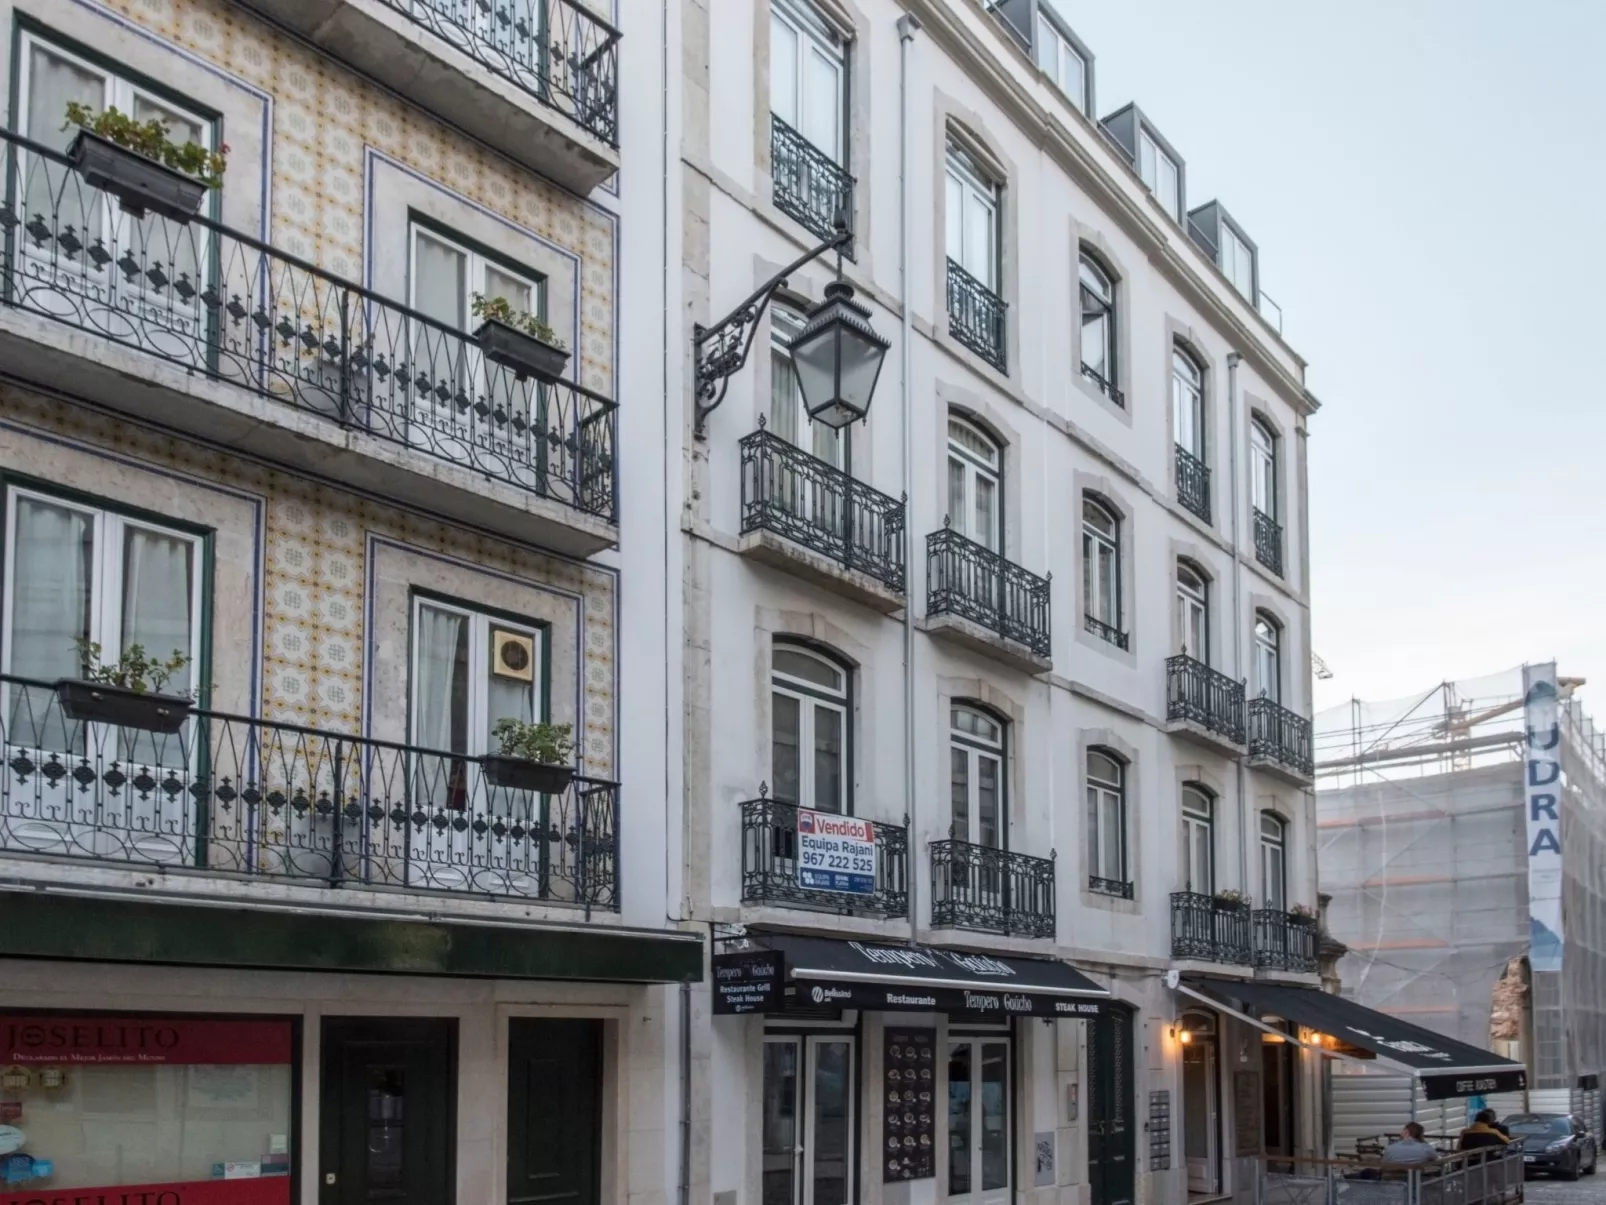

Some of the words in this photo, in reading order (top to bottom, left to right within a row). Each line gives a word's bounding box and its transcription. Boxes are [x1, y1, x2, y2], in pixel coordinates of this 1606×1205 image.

[1527, 724, 1561, 856] UDRA
[816, 818, 865, 837] Vendido
[801, 835, 839, 852] Equipa
[842, 841, 873, 857] Rajani
[803, 852, 825, 866] 967
[828, 855, 849, 869] 222
[852, 858, 873, 872] 525
[848, 941, 936, 969] Tempero
[719, 984, 756, 993] Restaurante
[757, 983, 771, 992] Grill
[726, 995, 743, 1003] Steak
[744, 994, 764, 1002] House
[886, 993, 936, 1005] Restaurante
[964, 990, 999, 1013] Tempero
[1055, 1002, 1077, 1012] STEAK
[1078, 1003, 1099, 1013] HOUSE
[7, 1024, 179, 1051] JOSELITO
